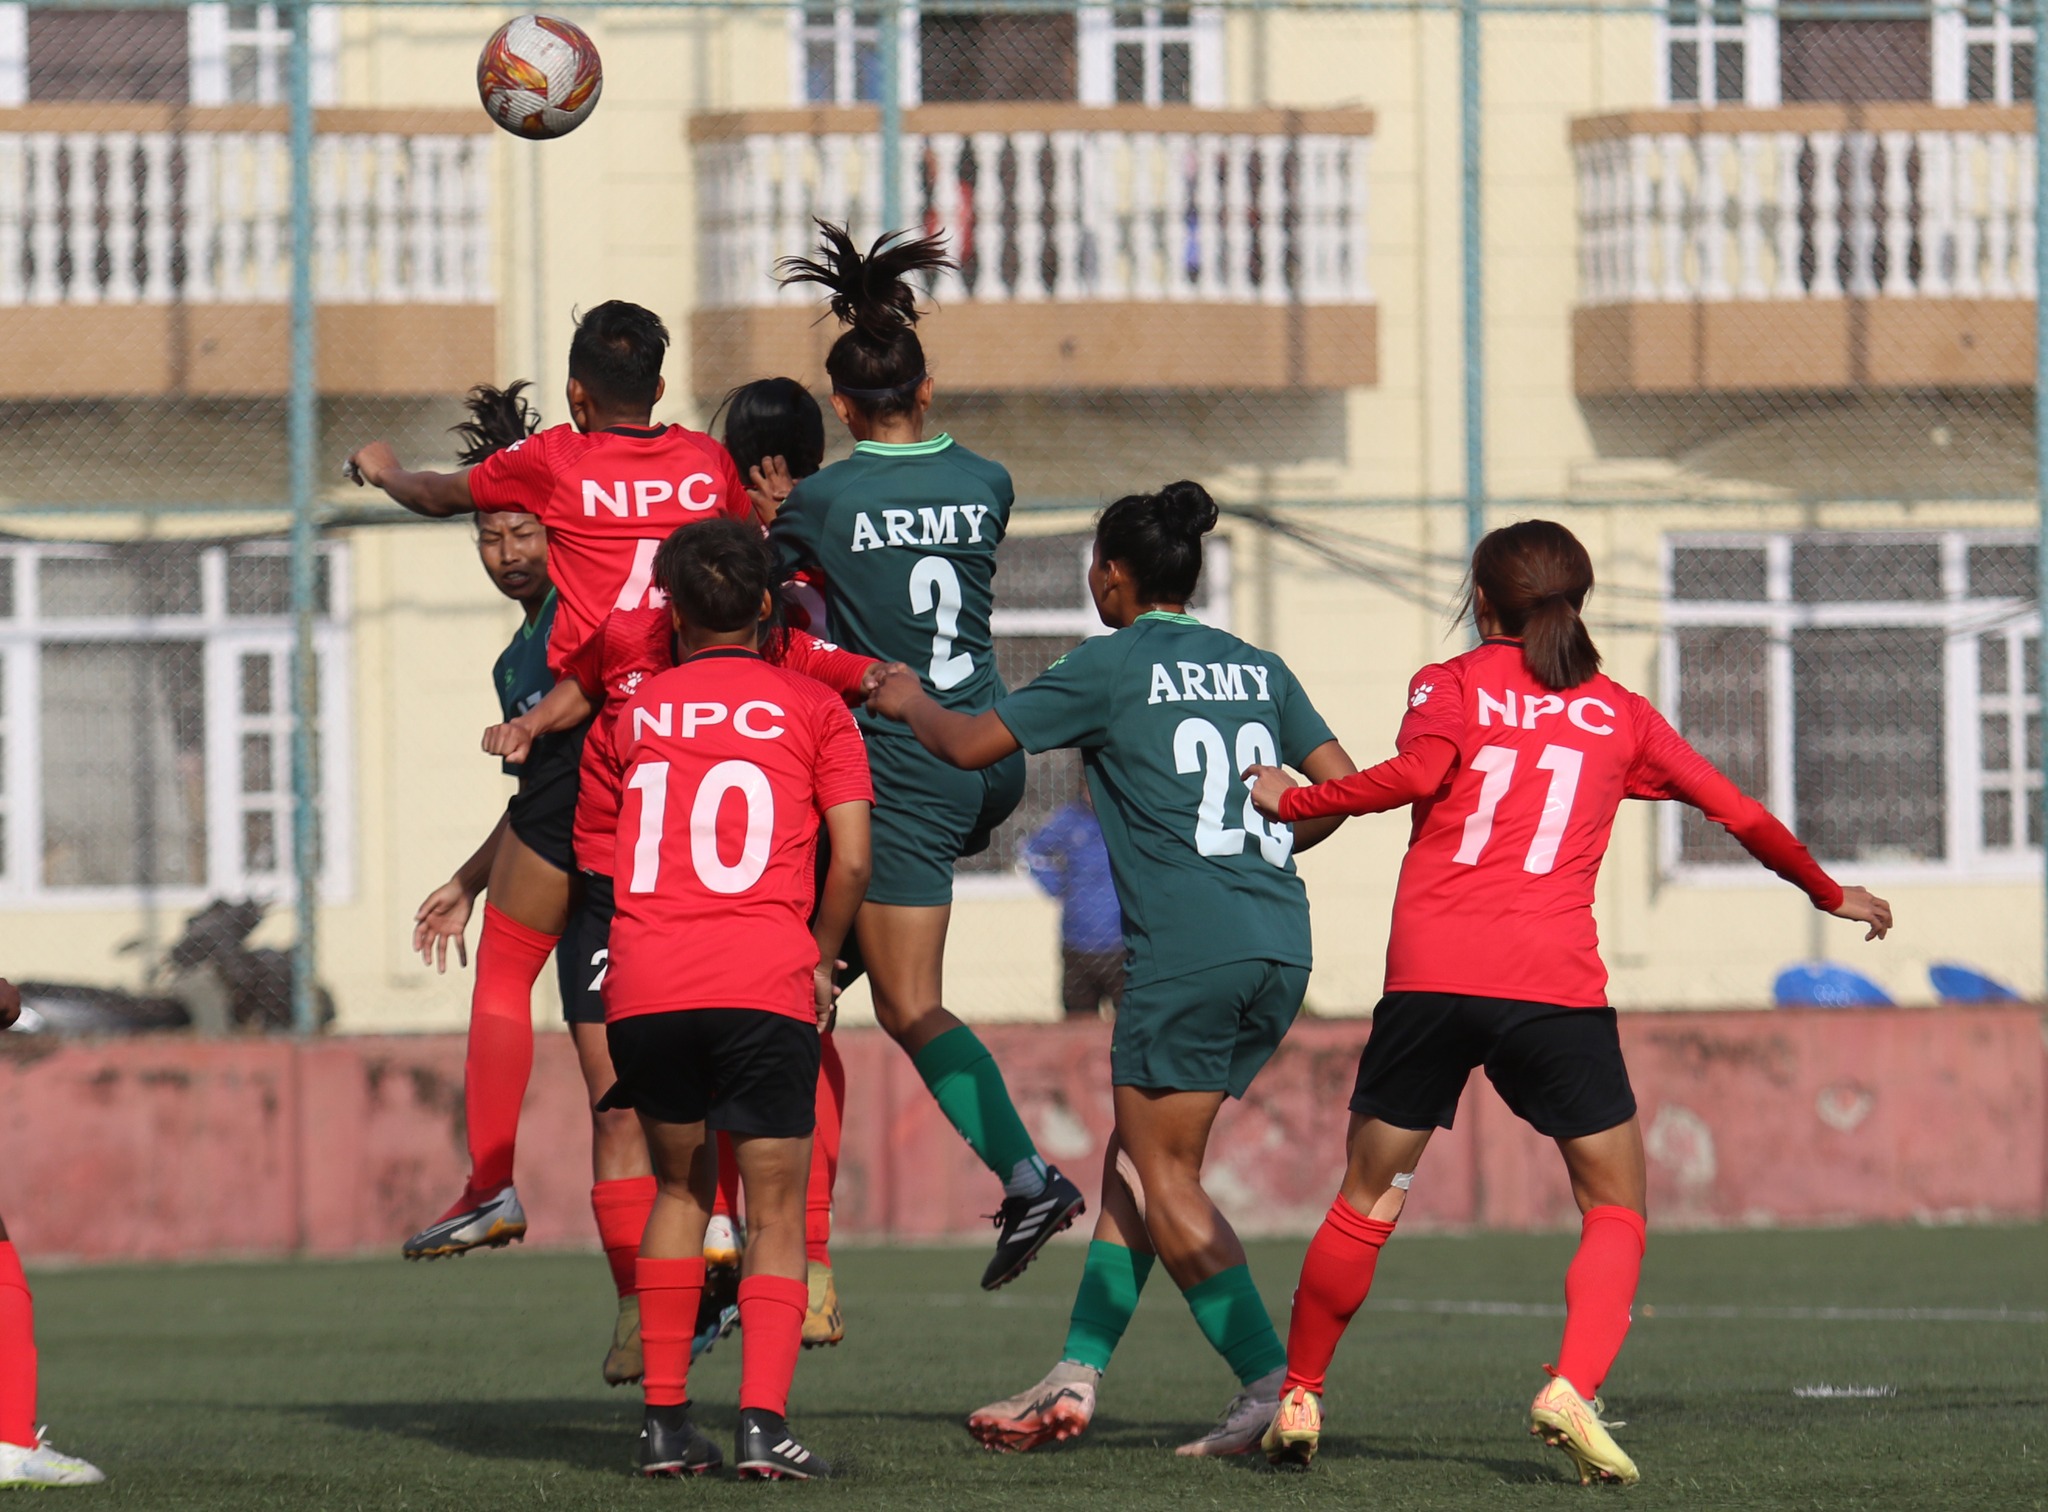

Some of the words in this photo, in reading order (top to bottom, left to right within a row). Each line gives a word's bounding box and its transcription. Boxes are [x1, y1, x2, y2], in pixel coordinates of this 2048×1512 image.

[582, 473, 717, 518] NPC
[851, 505, 988, 552] ARMY
[909, 556, 975, 691] 2
[1148, 661, 1270, 704] ARMY
[633, 700, 785, 742] NPC
[1477, 687, 1615, 736] NPC
[627, 760, 775, 894] 10
[1452, 743, 1584, 874] 11
